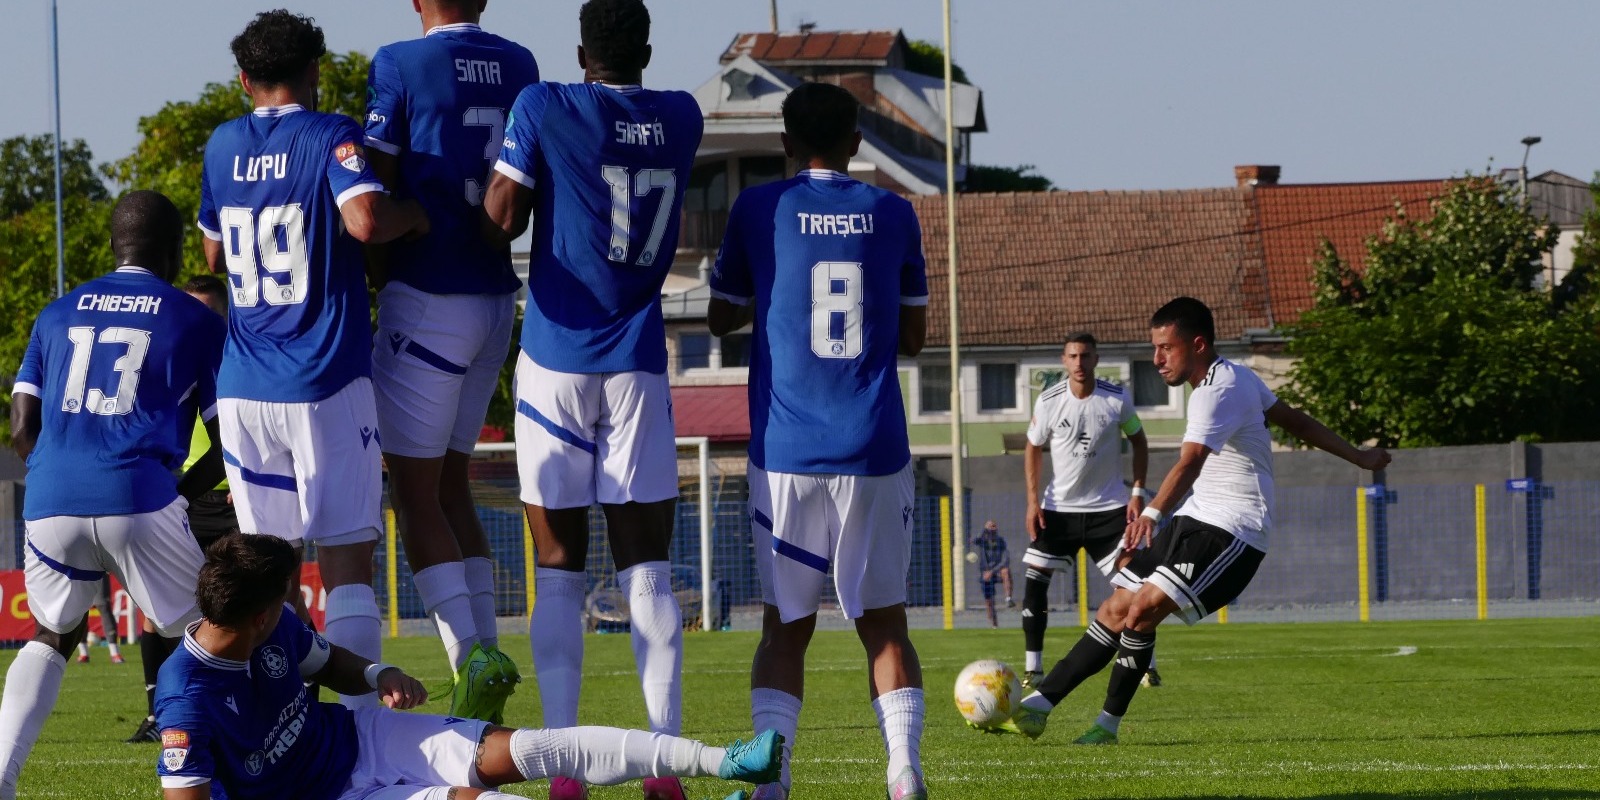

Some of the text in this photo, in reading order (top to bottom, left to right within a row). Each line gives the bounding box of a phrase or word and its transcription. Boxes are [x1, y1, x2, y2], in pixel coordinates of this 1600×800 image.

[454, 58, 502, 85] SIMA
[233, 153, 287, 182] LUPU
[463, 106, 505, 207] 3
[219, 203, 309, 307] 99
[601, 165, 677, 267] 17
[77, 294, 162, 315] CHIBSAH
[811, 261, 864, 359] 8
[61, 326, 153, 416] 13
[179, 750, 185, 758] 2
